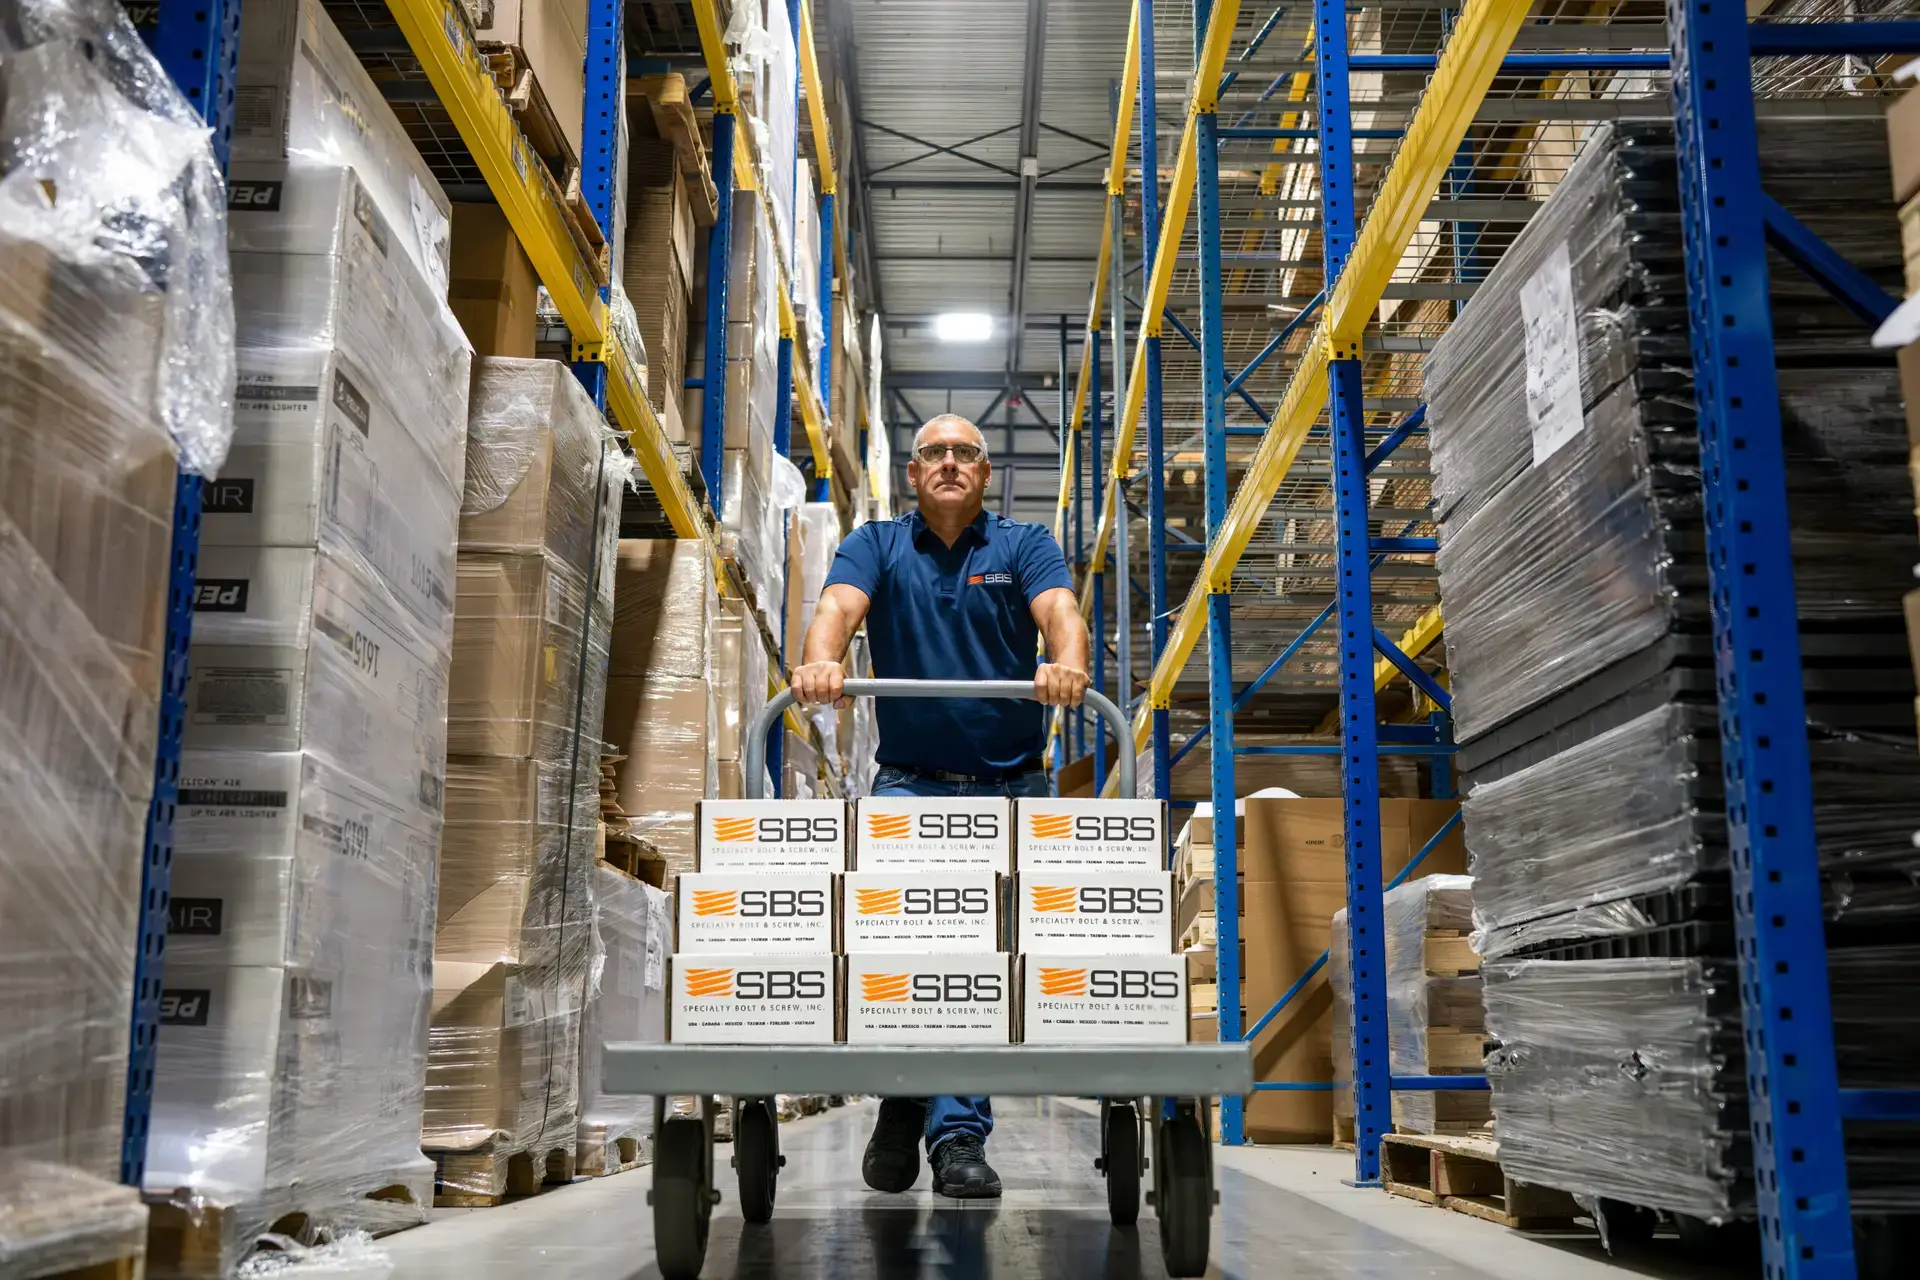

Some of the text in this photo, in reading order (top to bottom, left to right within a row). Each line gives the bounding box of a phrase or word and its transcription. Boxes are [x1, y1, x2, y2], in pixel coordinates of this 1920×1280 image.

[985, 573, 1012, 584] SBS
[759, 818, 837, 842] SBS
[919, 814, 998, 839] SBS
[1076, 816, 1155, 841] SBS
[740, 890, 824, 916] SBS
[904, 888, 988, 914] SBS
[1079, 887, 1163, 914] SBS
[736, 971, 825, 999] SBS
[912, 974, 1002, 1002] SBS
[1090, 970, 1179, 998] SBS
[770, 1004, 803, 1012] SCREW,
[946, 1007, 980, 1015] SCREW,
